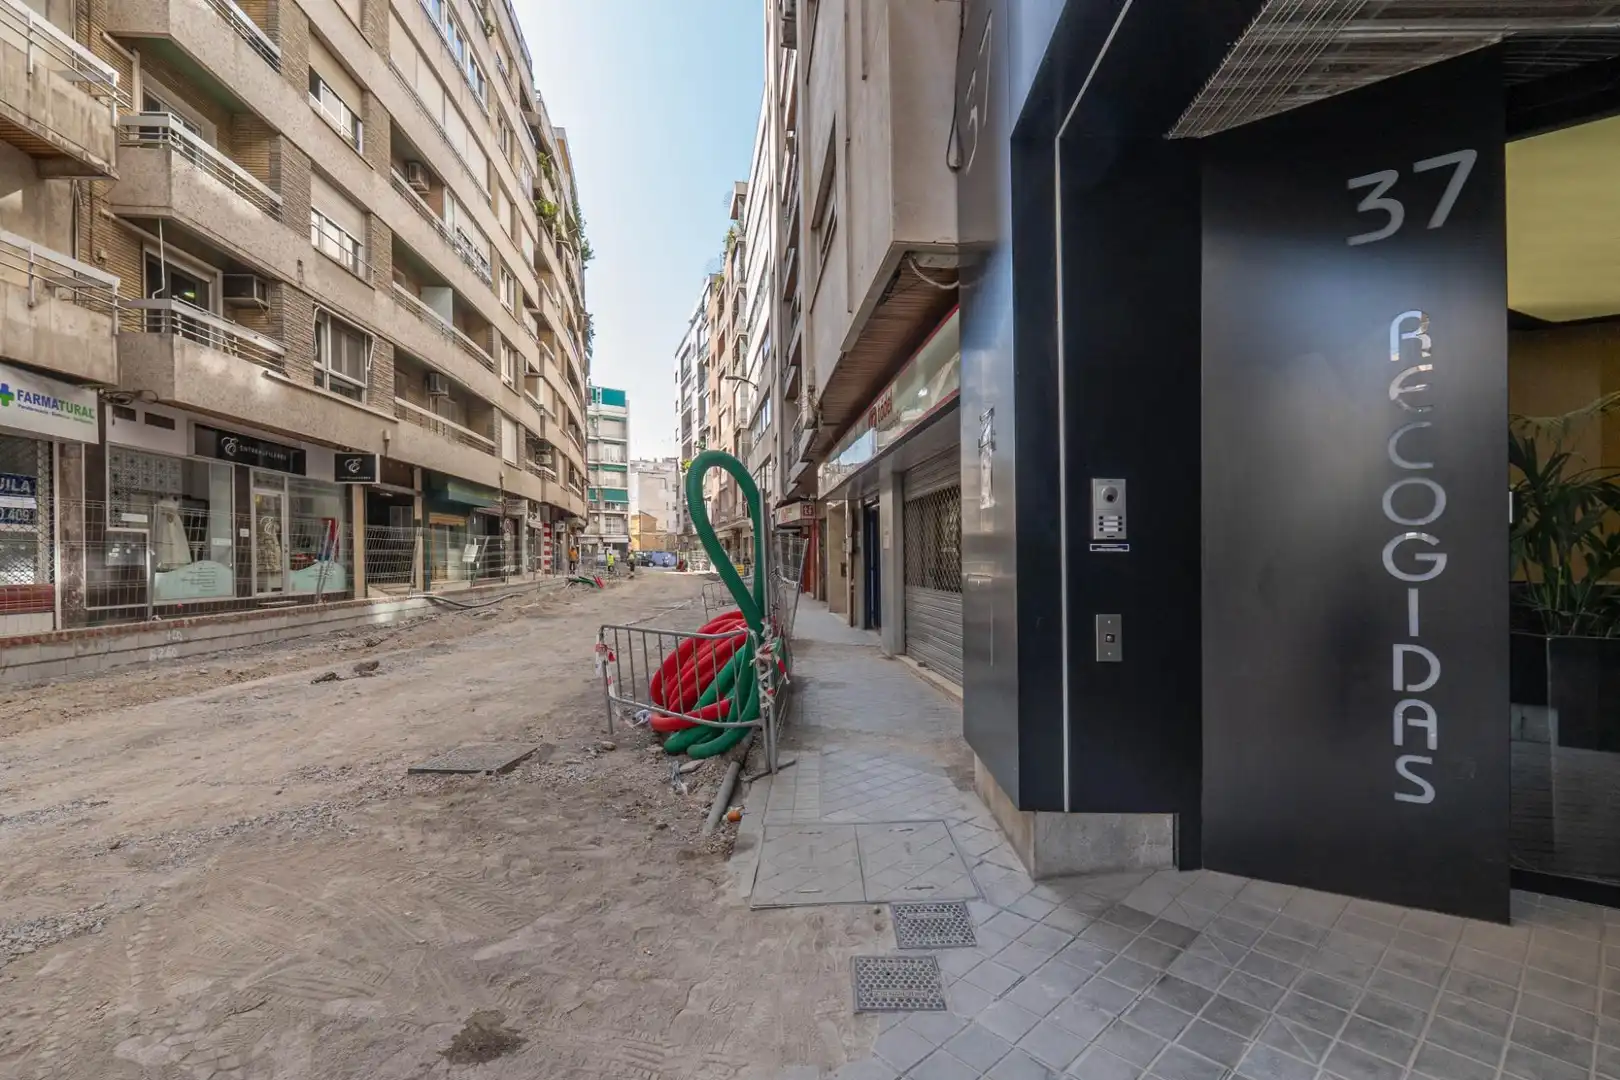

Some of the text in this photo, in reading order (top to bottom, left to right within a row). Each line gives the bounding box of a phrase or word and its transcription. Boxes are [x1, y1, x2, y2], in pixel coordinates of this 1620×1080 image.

[1346, 148, 1478, 247] 37
[16, 388, 96, 420] FARMATURAL
[1381, 308, 1448, 805] RECOGIDAS
